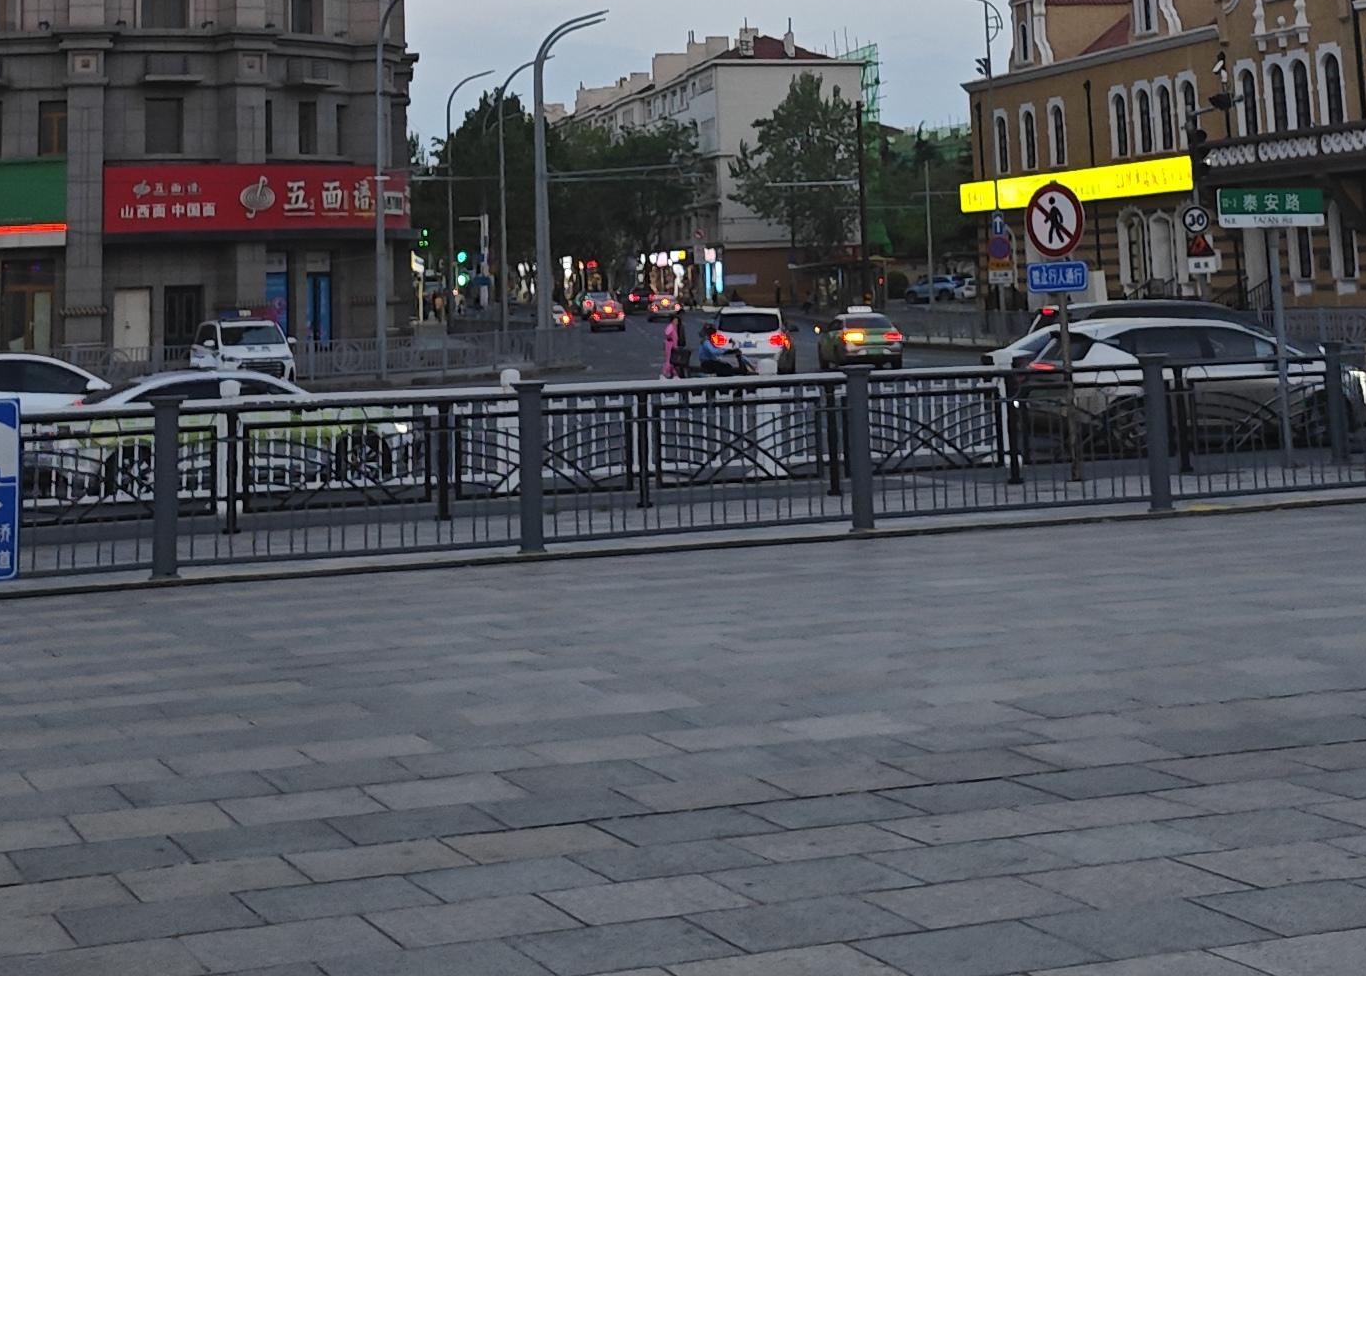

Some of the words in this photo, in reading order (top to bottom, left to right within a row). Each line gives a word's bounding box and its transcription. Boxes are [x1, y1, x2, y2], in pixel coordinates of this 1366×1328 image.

[120, 203, 166, 219] 山西面
[171, 202, 216, 219] 中国面
[1242, 193, 1301, 212] 泰安路
[1188, 213, 1205, 227] 30
[1031, 266, 1084, 286] 禁止行人通行
